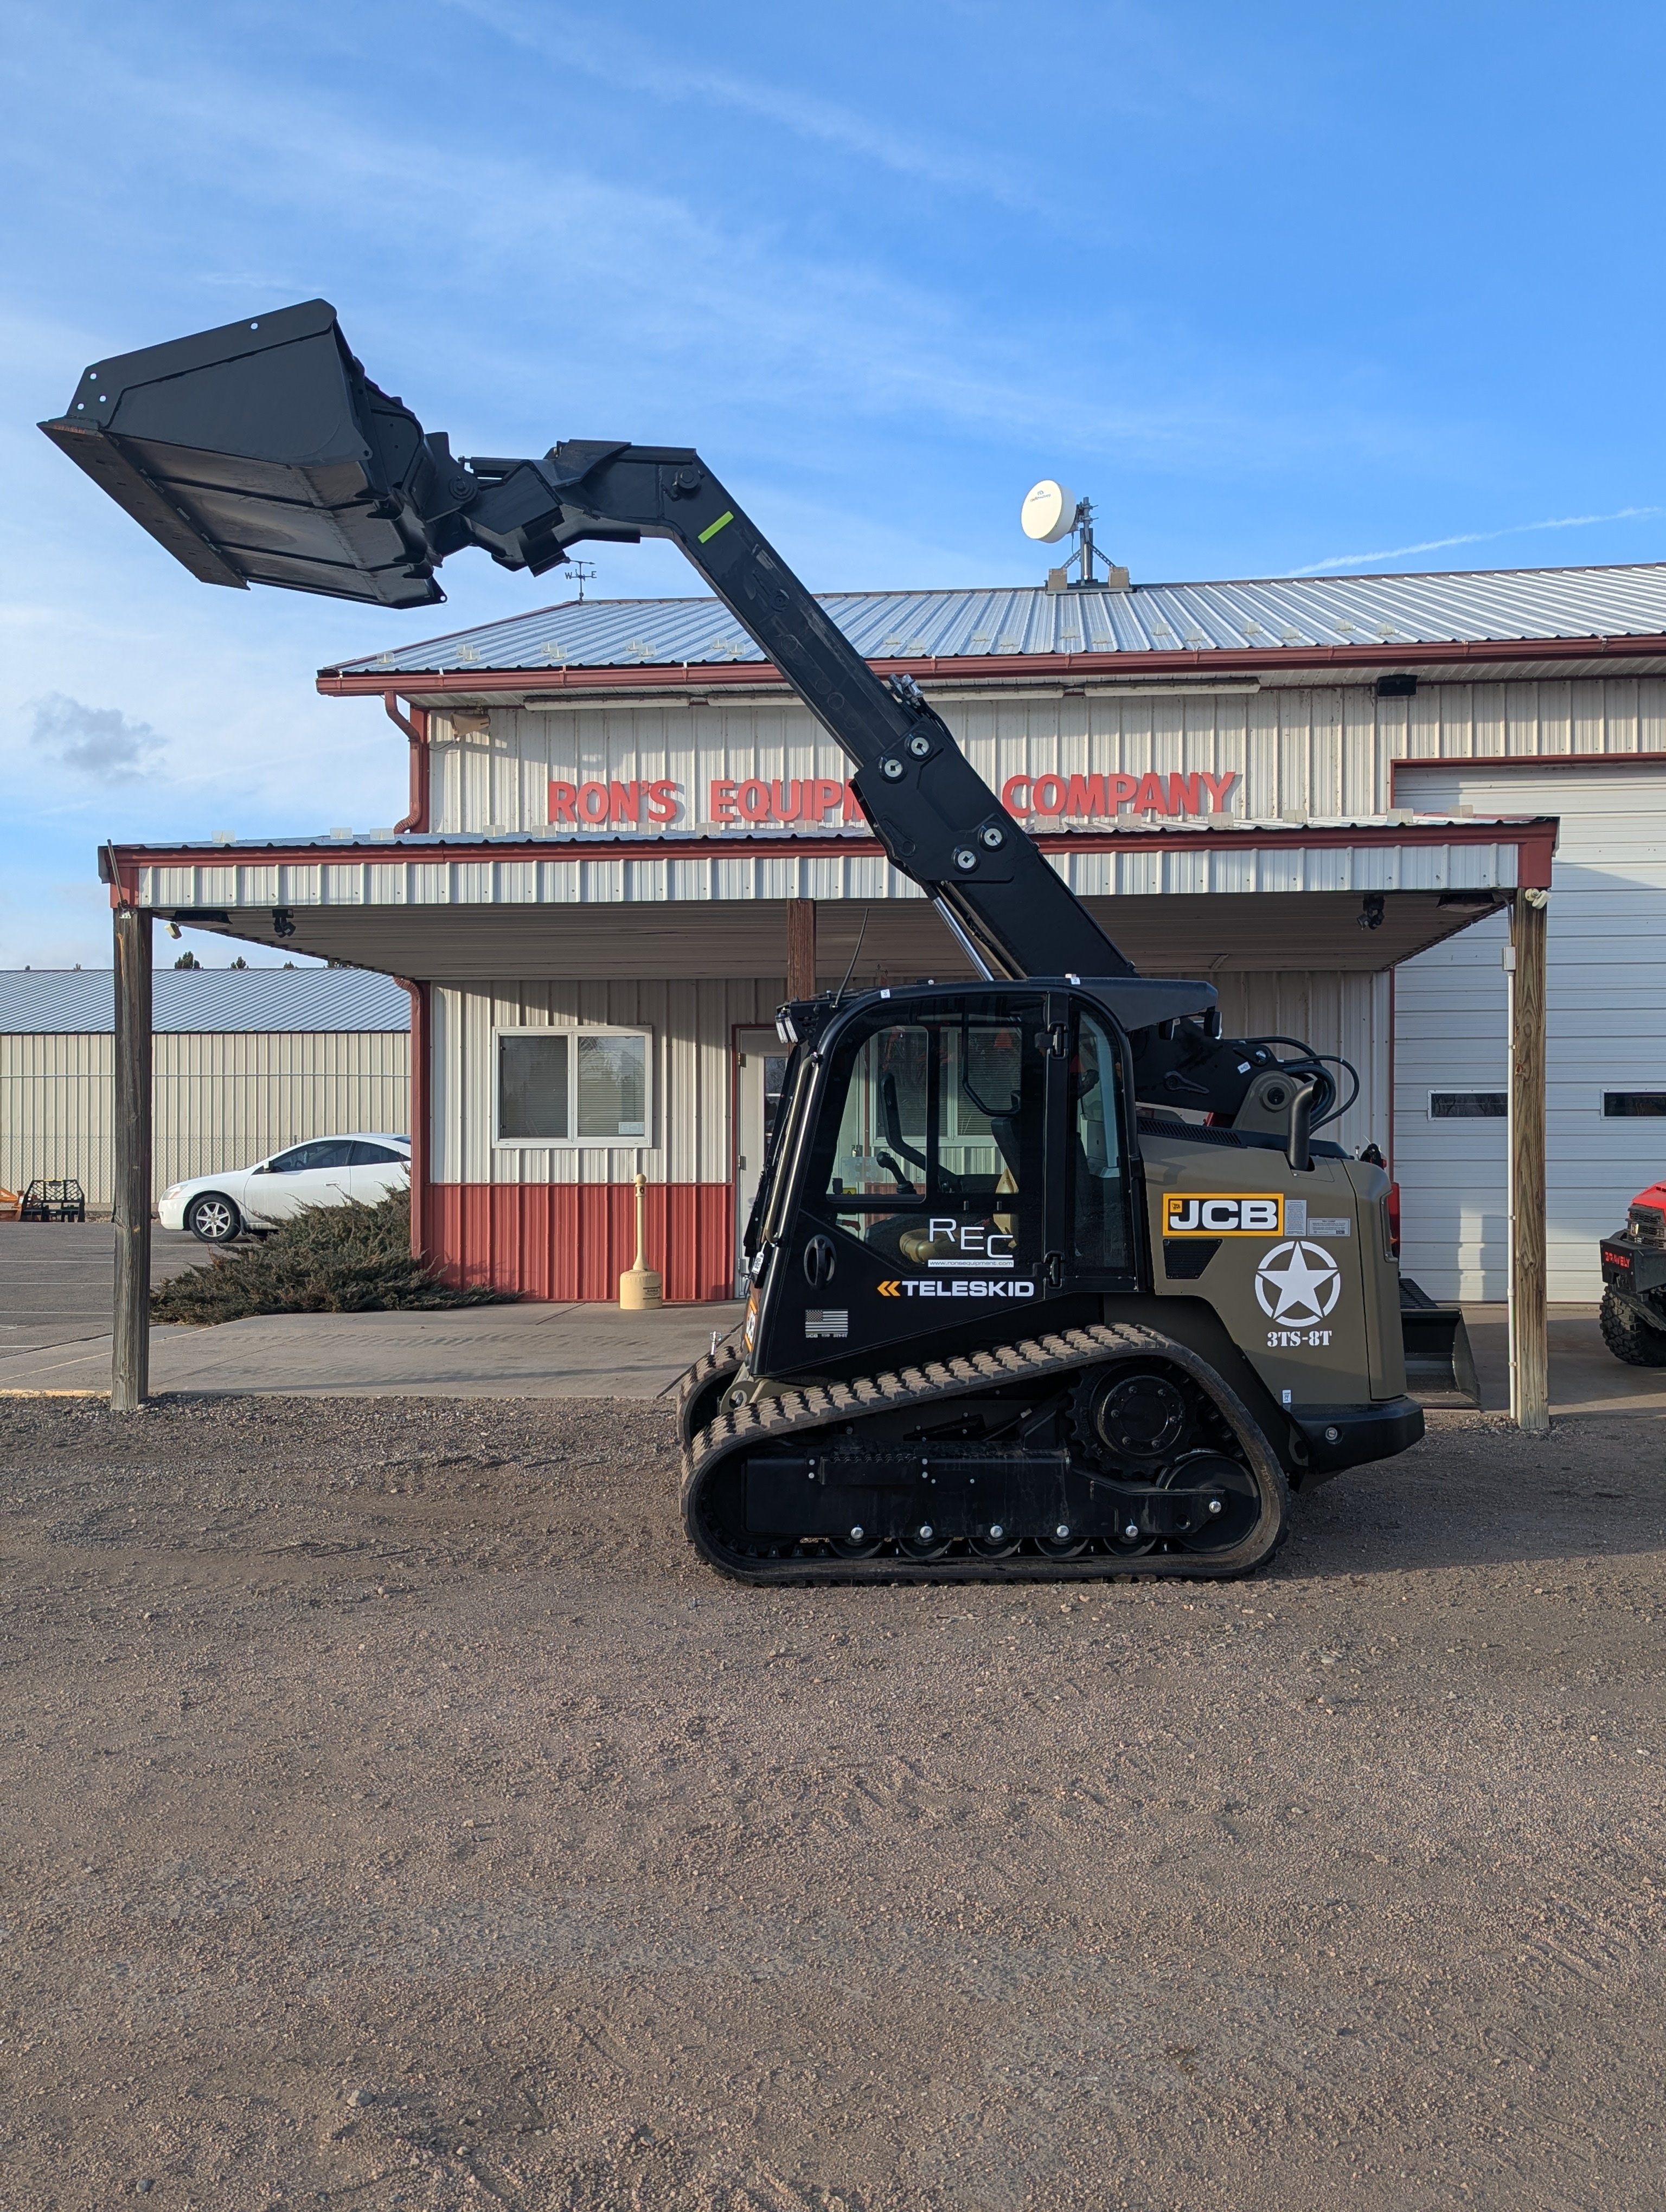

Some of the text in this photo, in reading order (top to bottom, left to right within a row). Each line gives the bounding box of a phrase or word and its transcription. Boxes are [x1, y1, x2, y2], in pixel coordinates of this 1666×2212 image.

[549, 779, 677, 823] RON'S
[1002, 771, 1236, 818] COMPANY
[1170, 1200, 1278, 1230] JCB
[929, 1218, 1014, 1258] REC
[901, 1281, 1034, 1296] TELESKID
[1267, 1330, 1332, 1347] 3TS-8T
